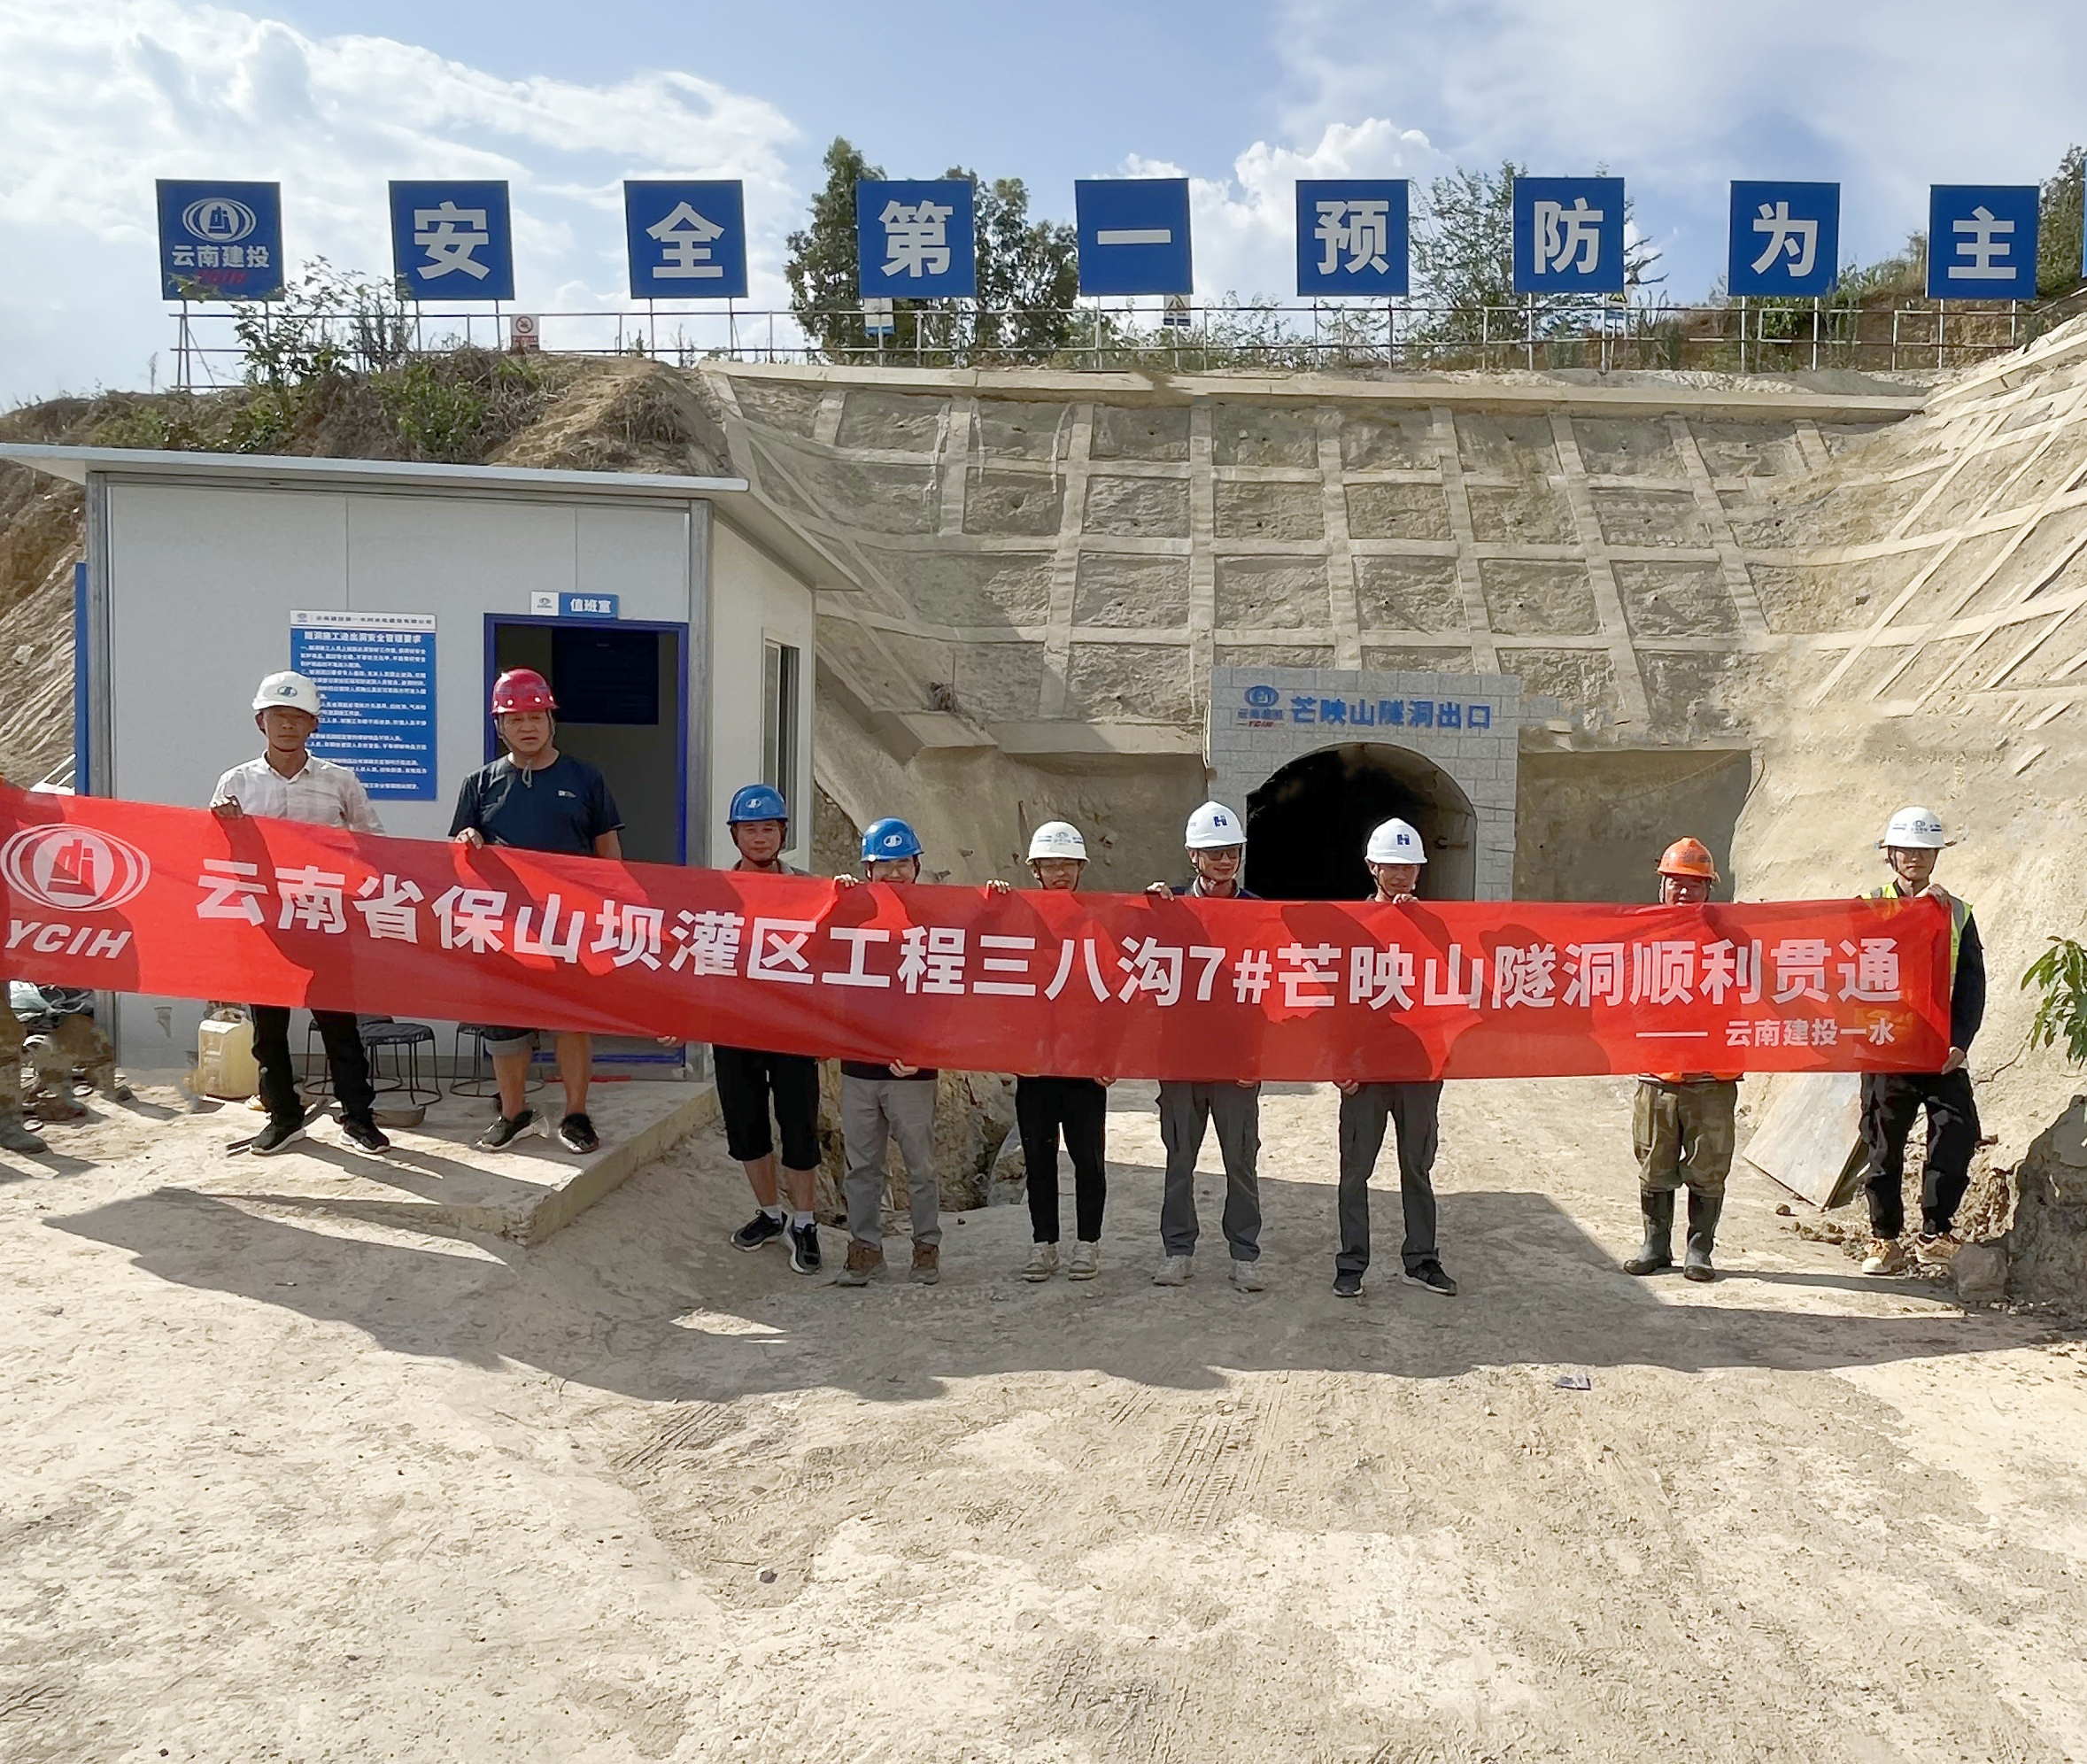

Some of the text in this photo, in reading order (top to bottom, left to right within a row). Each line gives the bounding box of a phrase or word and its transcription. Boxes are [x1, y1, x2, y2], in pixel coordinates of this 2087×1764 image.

[172, 244, 270, 268] 云南建投
[570, 598, 612, 614] 值班室
[1290, 696, 1491, 730] 芒映山隧洞出口
[4, 918, 133, 959] YCIH
[197, 857, 1901, 1011] 云南省保山坝灌区工程三八沟7#芒映山隧洞顺利贯通
[1725, 1017, 1896, 1047] 云南建投一水
